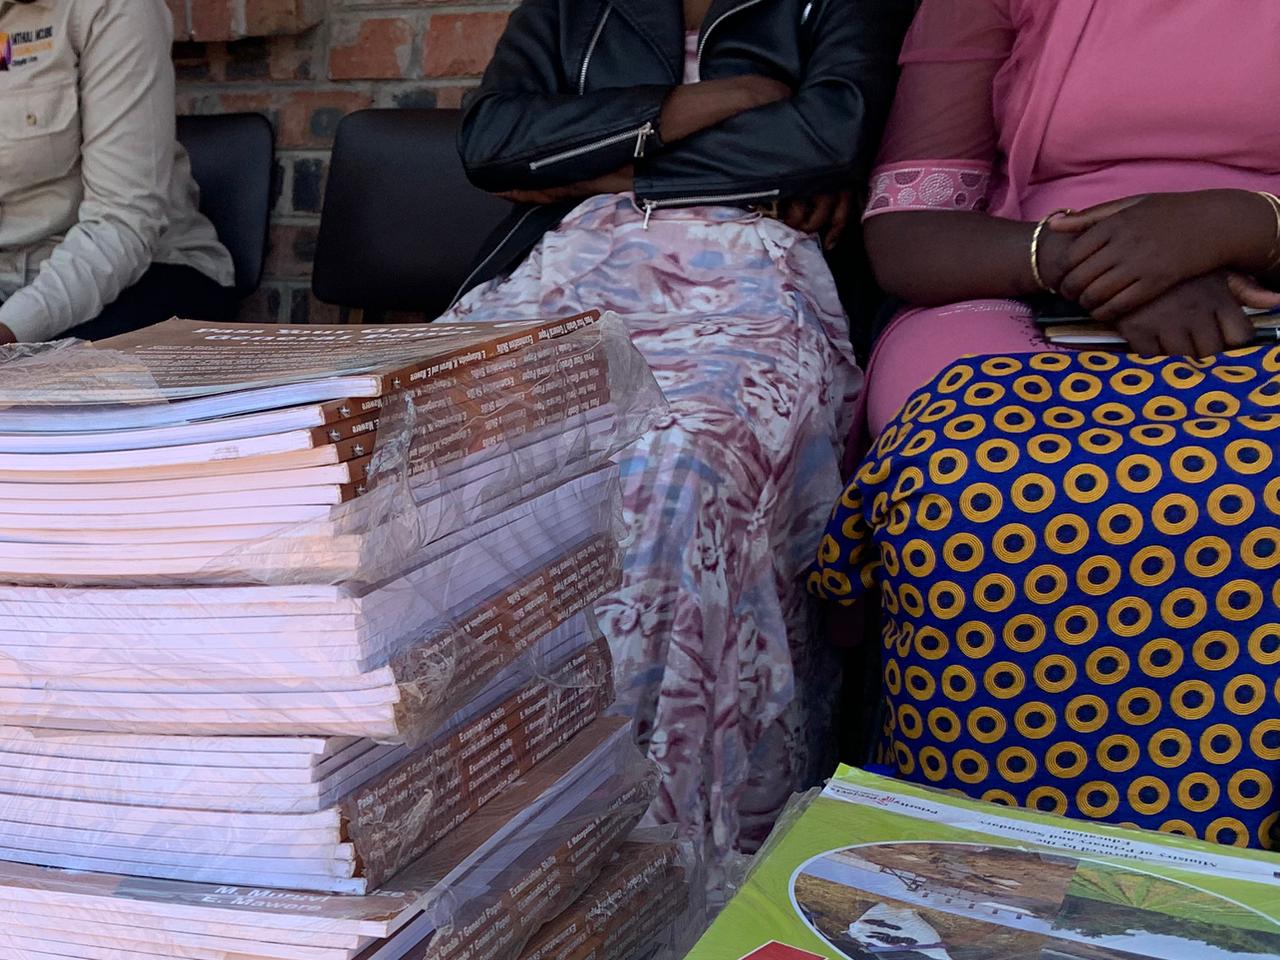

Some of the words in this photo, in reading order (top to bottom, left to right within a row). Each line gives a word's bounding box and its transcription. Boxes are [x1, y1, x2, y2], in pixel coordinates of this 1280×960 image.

[893, 799, 938, 816] Priority
[1159, 852, 1218, 868] Ministry
[439, 935, 458, 957] Grade
[463, 912, 485, 936] General
